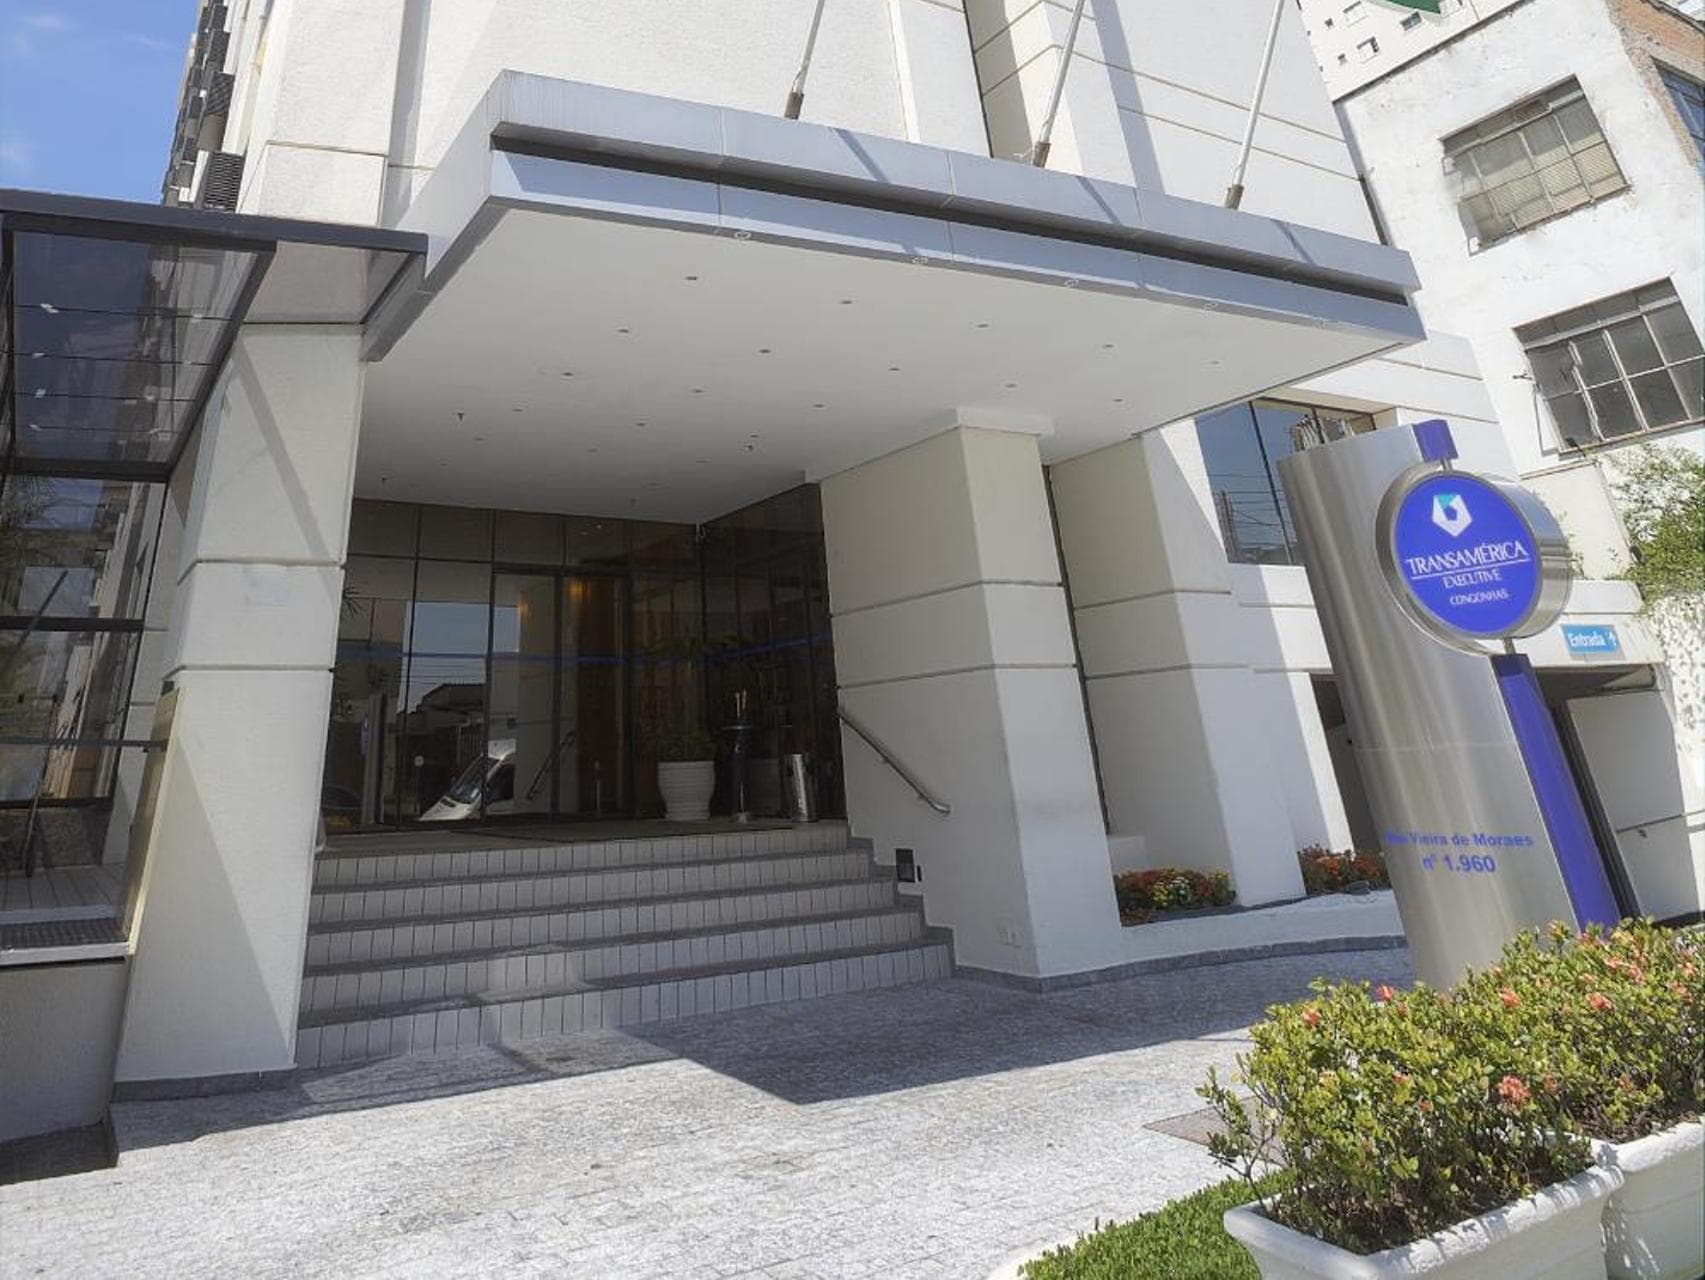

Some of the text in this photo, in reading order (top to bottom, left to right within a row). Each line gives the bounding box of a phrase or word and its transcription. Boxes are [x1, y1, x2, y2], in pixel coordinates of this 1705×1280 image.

[1406, 540, 1529, 575] TRANSAMÉRICA
[1443, 570, 1502, 588] EXECUTIVE
[1450, 588, 1509, 605] CONGONHAS
[1568, 632, 1606, 647] Entrada
[1451, 833, 1470, 846] de
[1473, 833, 1533, 847] Moraes
[1444, 854, 1496, 873] 1.960
